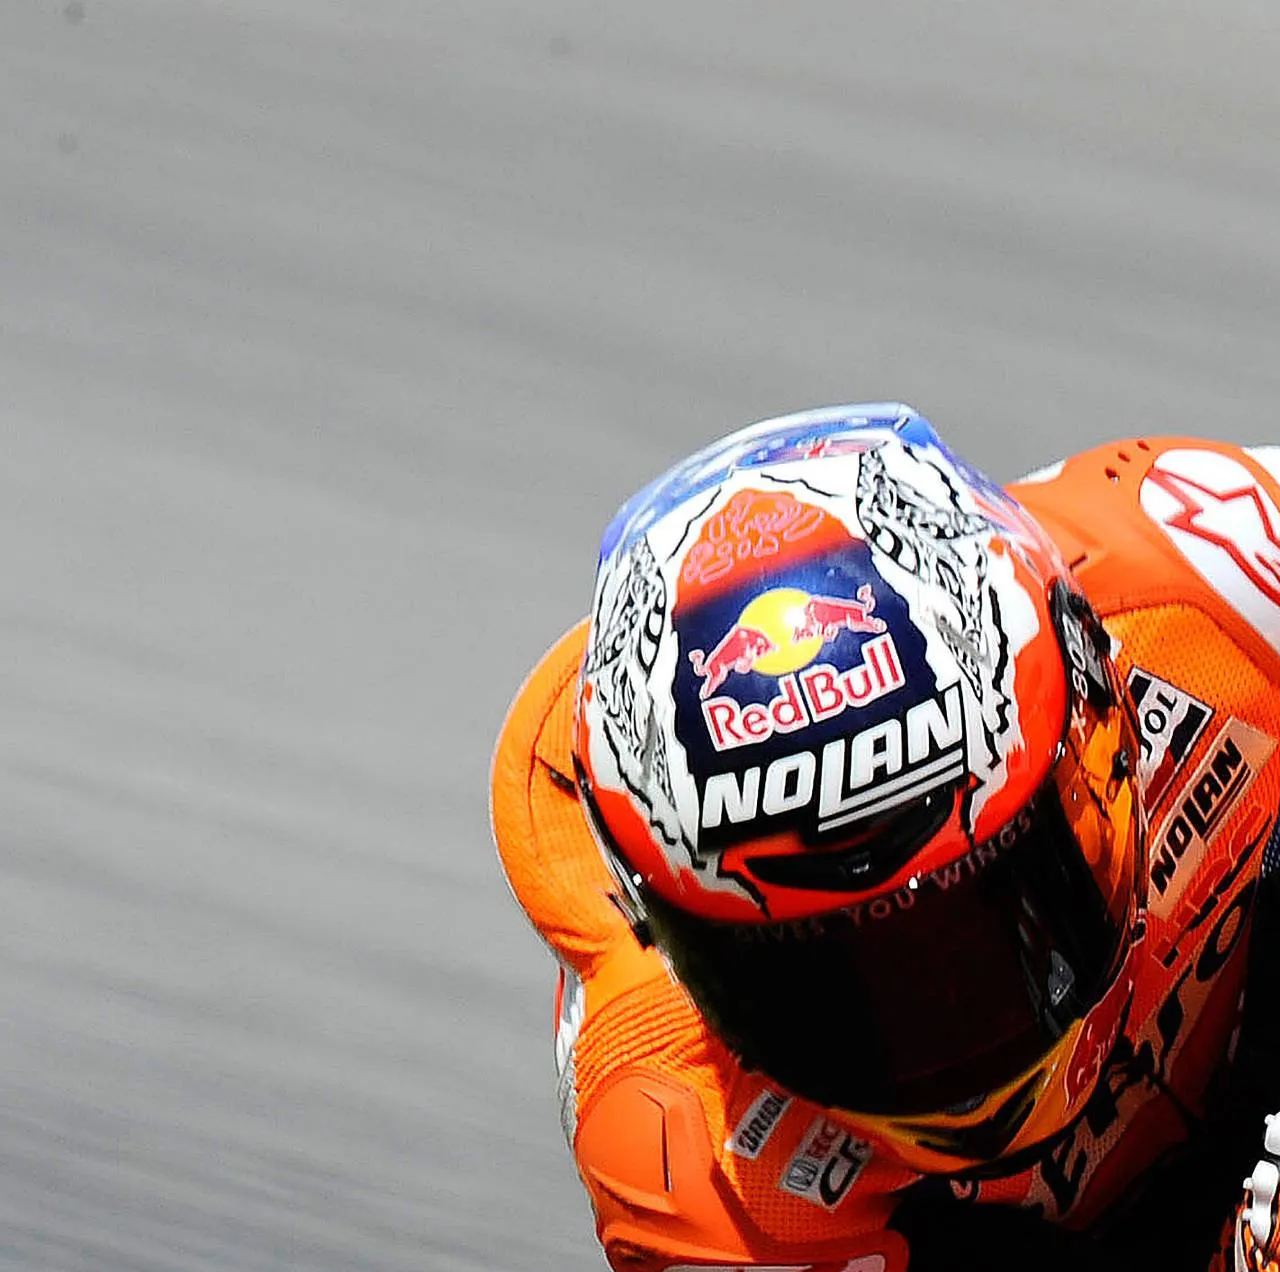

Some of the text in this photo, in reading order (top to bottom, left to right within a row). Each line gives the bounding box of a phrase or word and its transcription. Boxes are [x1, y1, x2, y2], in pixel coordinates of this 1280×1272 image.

[708, 637, 902, 740] Red Bull
[701, 686, 966, 833] NOLAN
[1150, 736, 1246, 895] NOLAN
[845, 886, 917, 931] YOU
